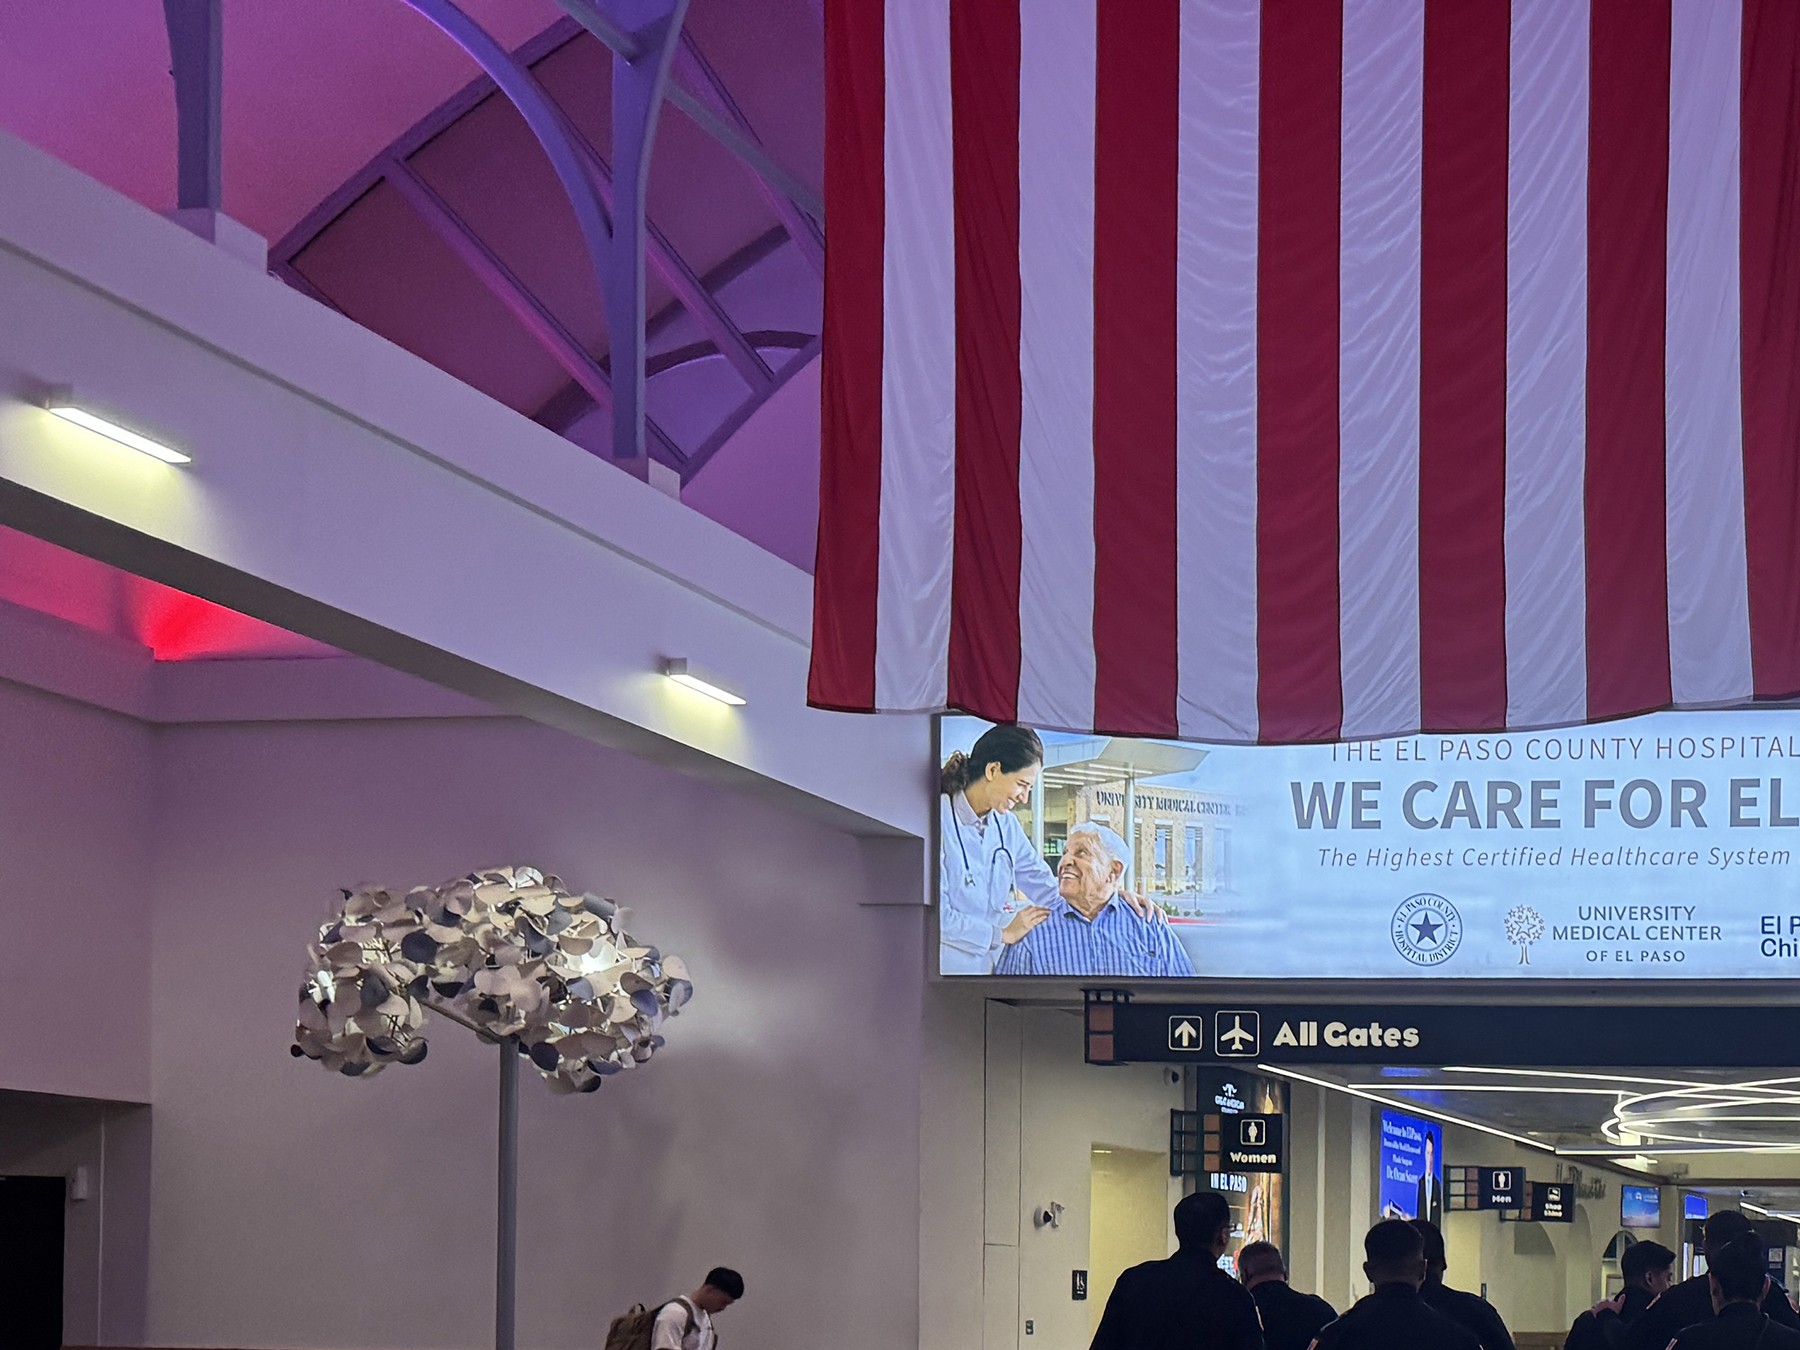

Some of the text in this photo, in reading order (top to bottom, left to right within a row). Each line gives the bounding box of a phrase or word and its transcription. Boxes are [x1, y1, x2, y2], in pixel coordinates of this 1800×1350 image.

[1396, 739, 1426, 761] EL
[1440, 738, 1512, 761] PASO
[1526, 737, 1644, 760] COUNTY
[1656, 735, 1800, 759] HOSPITAL
[1290, 780, 1382, 829] WE
[1402, 779, 1561, 829] CARE
[1584, 778, 1708, 829] FOR
[1729, 778, 1800, 828] EL
[1319, 848, 1357, 866] The
[1366, 847, 1454, 871] Highest
[1462, 846, 1561, 867] Certified
[1570, 845, 1699, 866] Healthcare
[1707, 846, 1791, 870] System
[1405, 897, 1427, 912] PASO
[1428, 897, 1457, 922] COUNTY
[1578, 905, 1696, 921] UNIVERSITY
[1552, 925, 1722, 941] MEDICAL CENTER
[1760, 916, 1781, 935] El
[1395, 930, 1459, 962] HOSPITAL DISTRICT
[1586, 950, 1686, 962] OF EL PASO
[1272, 1021, 1420, 1048] All Gates
[1230, 1151, 1277, 1164] Women
[1219, 1173, 1229, 1191] EL
[1229, 1174, 1247, 1193] PASO
[1492, 1195, 1512, 1203] Men
